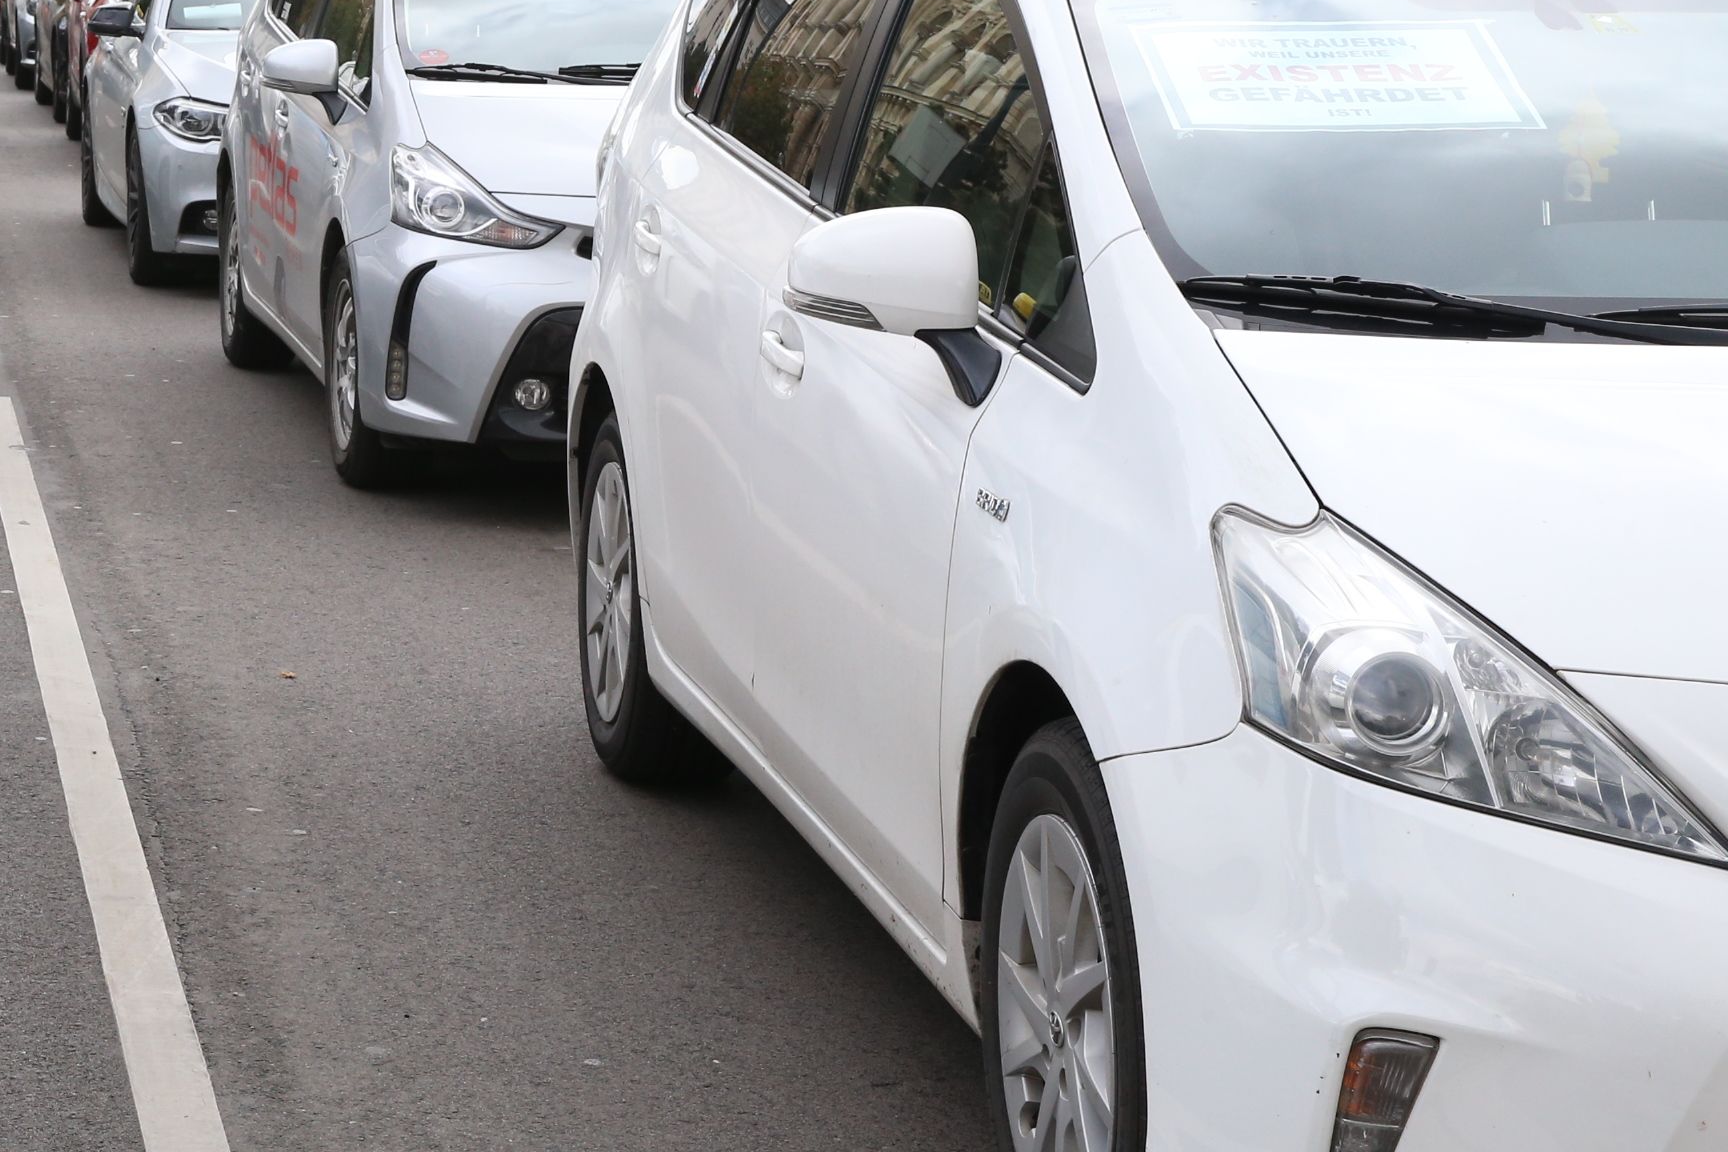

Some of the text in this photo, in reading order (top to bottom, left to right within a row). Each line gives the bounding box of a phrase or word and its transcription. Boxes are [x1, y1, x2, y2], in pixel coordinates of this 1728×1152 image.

[1211, 36, 1417, 51] WIR TRAUERN,
[1248, 49, 1393, 58] WEIL UNSERE
[1197, 63, 1464, 83] EXISTENZ
[1208, 85, 1470, 103] GEFÄHRDET
[1327, 108, 1373, 117] IST!
